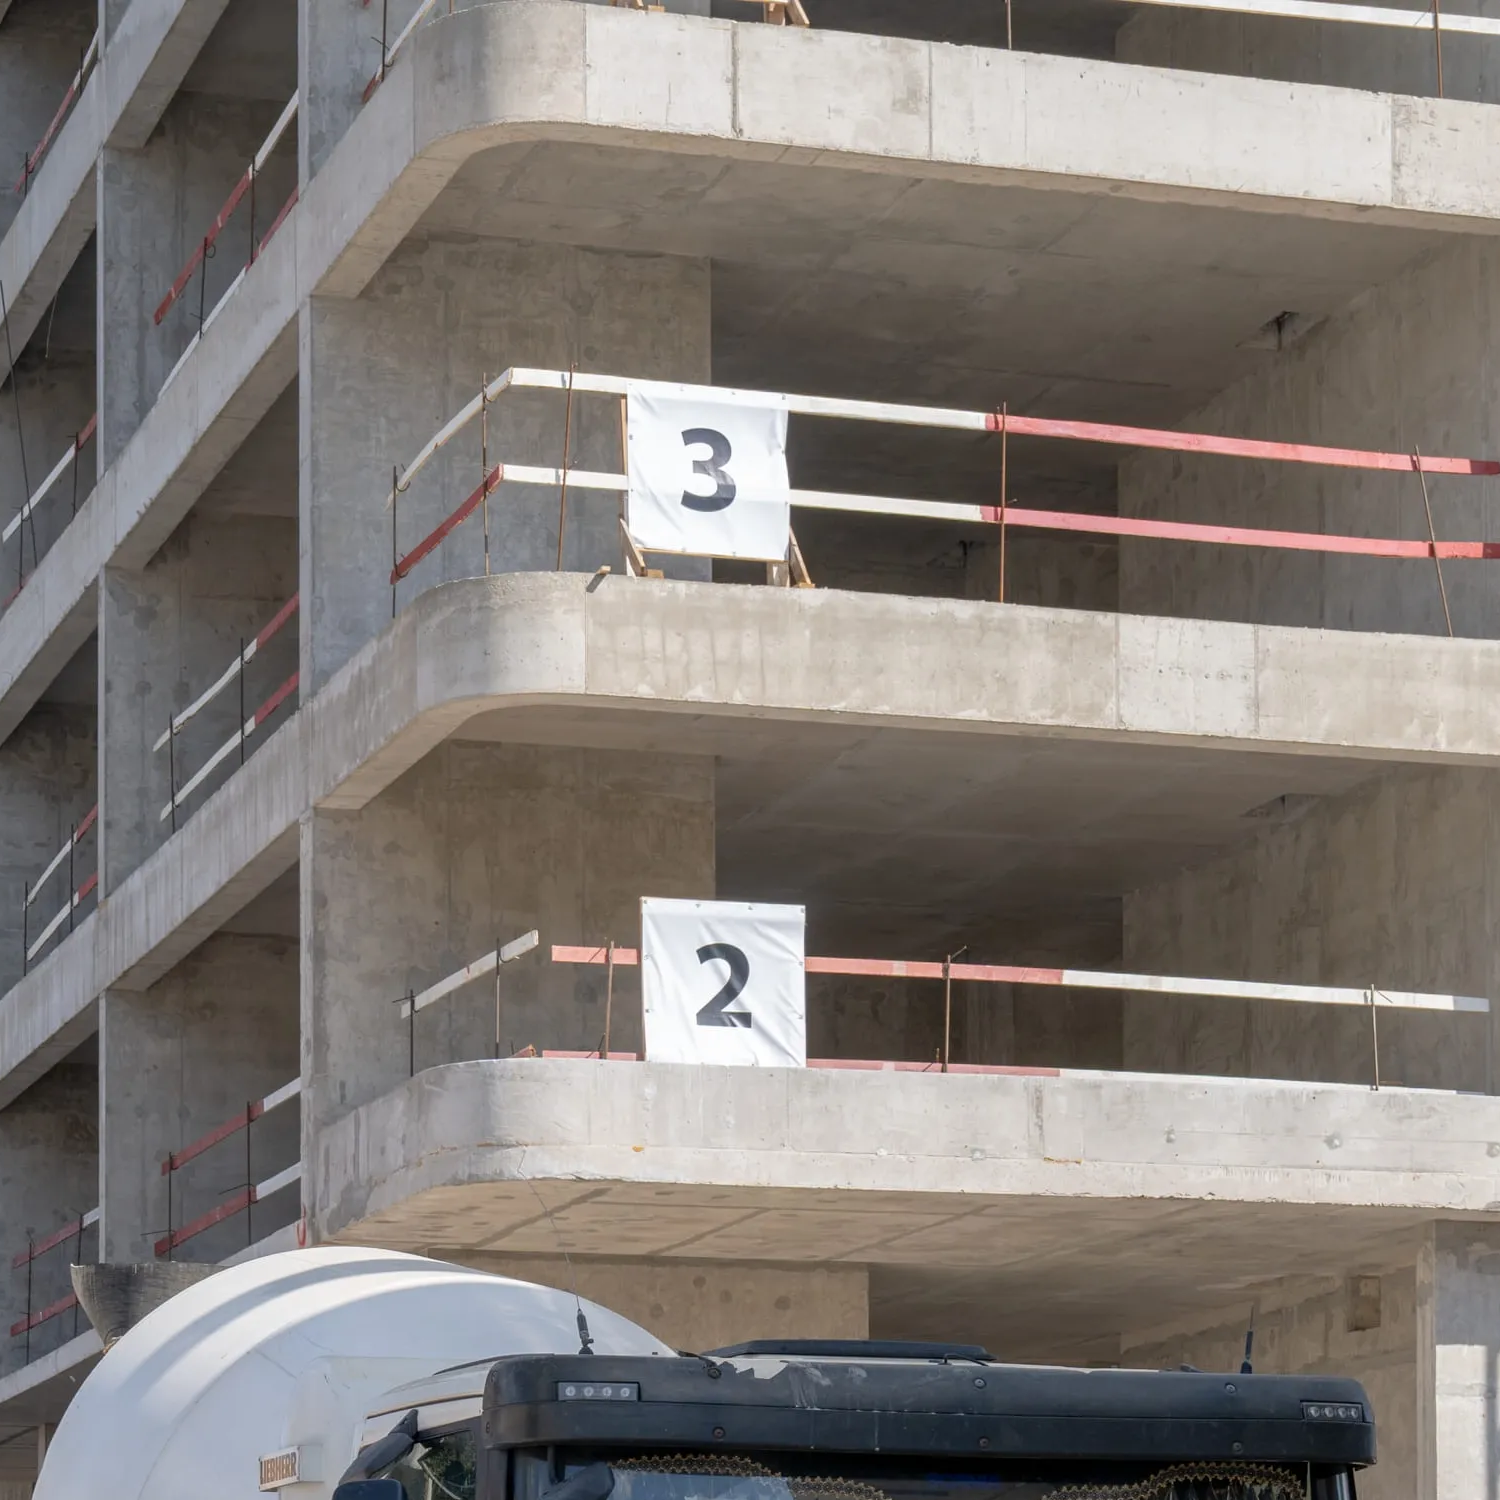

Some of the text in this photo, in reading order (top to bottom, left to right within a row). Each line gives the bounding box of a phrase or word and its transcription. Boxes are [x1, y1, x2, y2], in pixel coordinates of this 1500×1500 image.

[681, 427, 736, 513] 3
[695, 943, 752, 1029] 2
[260, 1451, 297, 1485] LIEBHERR
